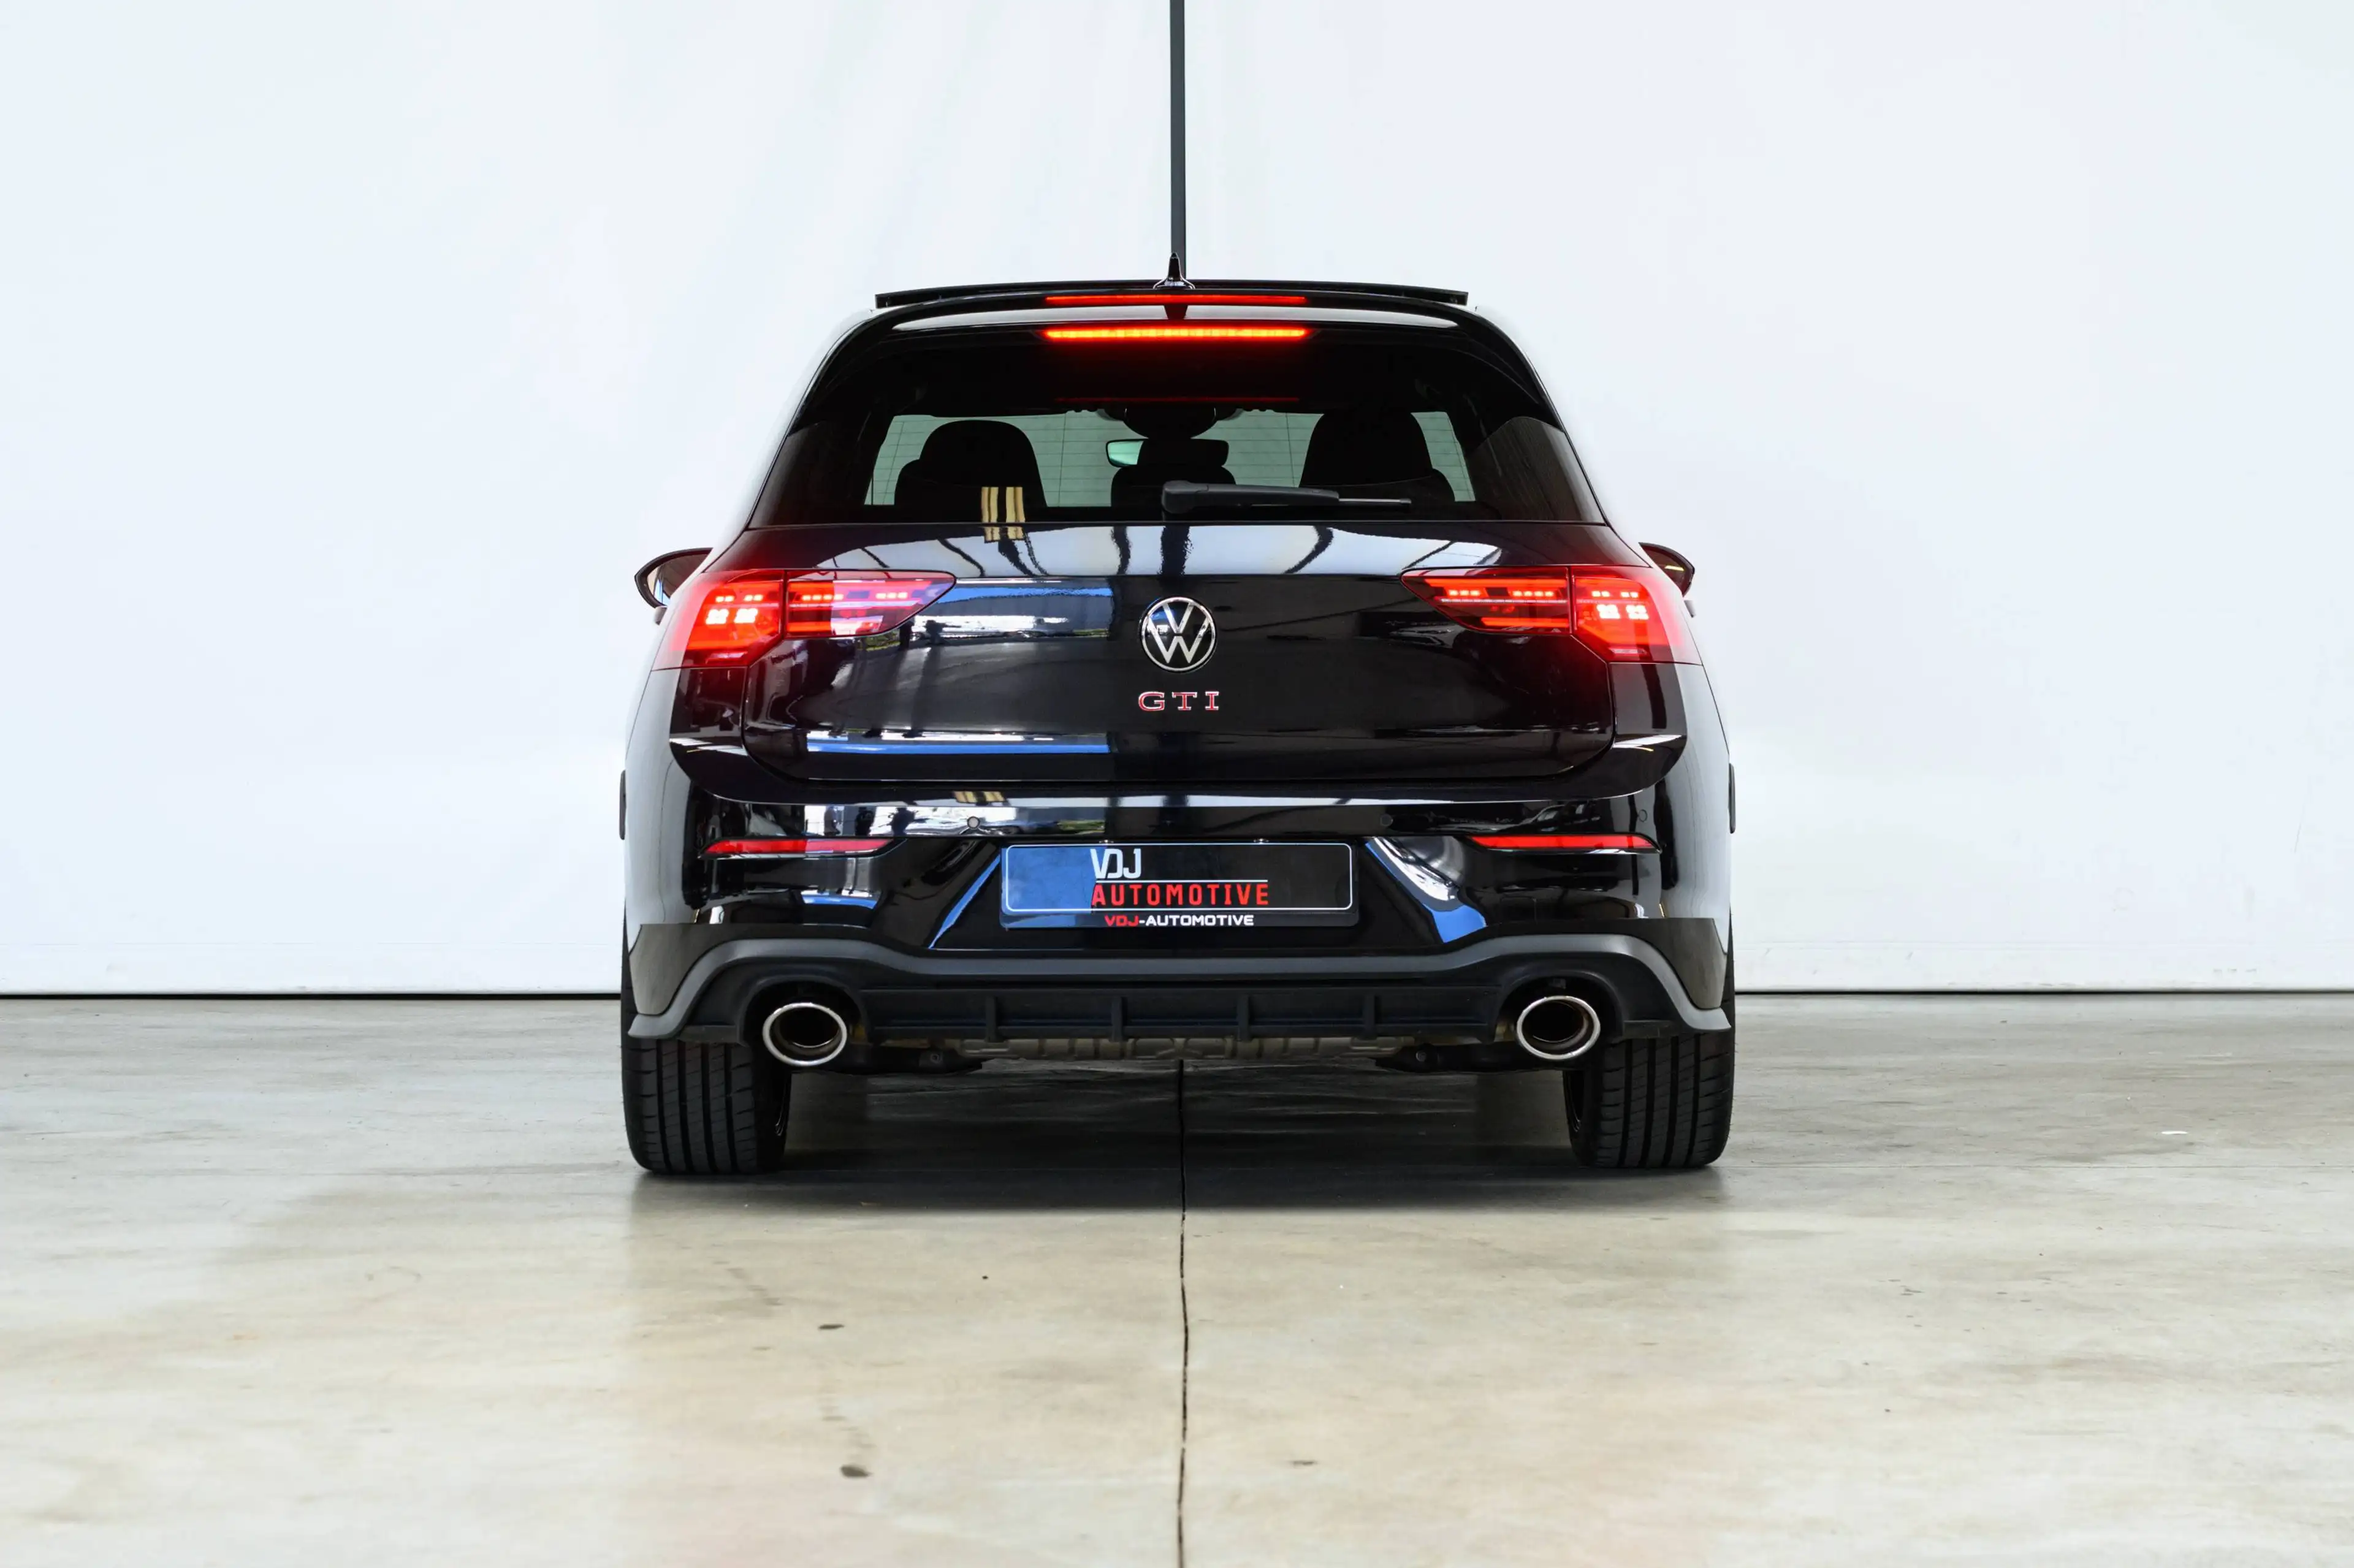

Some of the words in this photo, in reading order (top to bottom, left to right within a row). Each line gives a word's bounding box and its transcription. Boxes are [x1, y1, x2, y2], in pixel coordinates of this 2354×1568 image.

[1138, 691, 1220, 712] GTI
[1090, 848, 1141, 879] VDJ
[1091, 883, 1269, 906] AUTOMOTIVE
[1104, 915, 1254, 927] VDJ-AUTOMOTIVE
